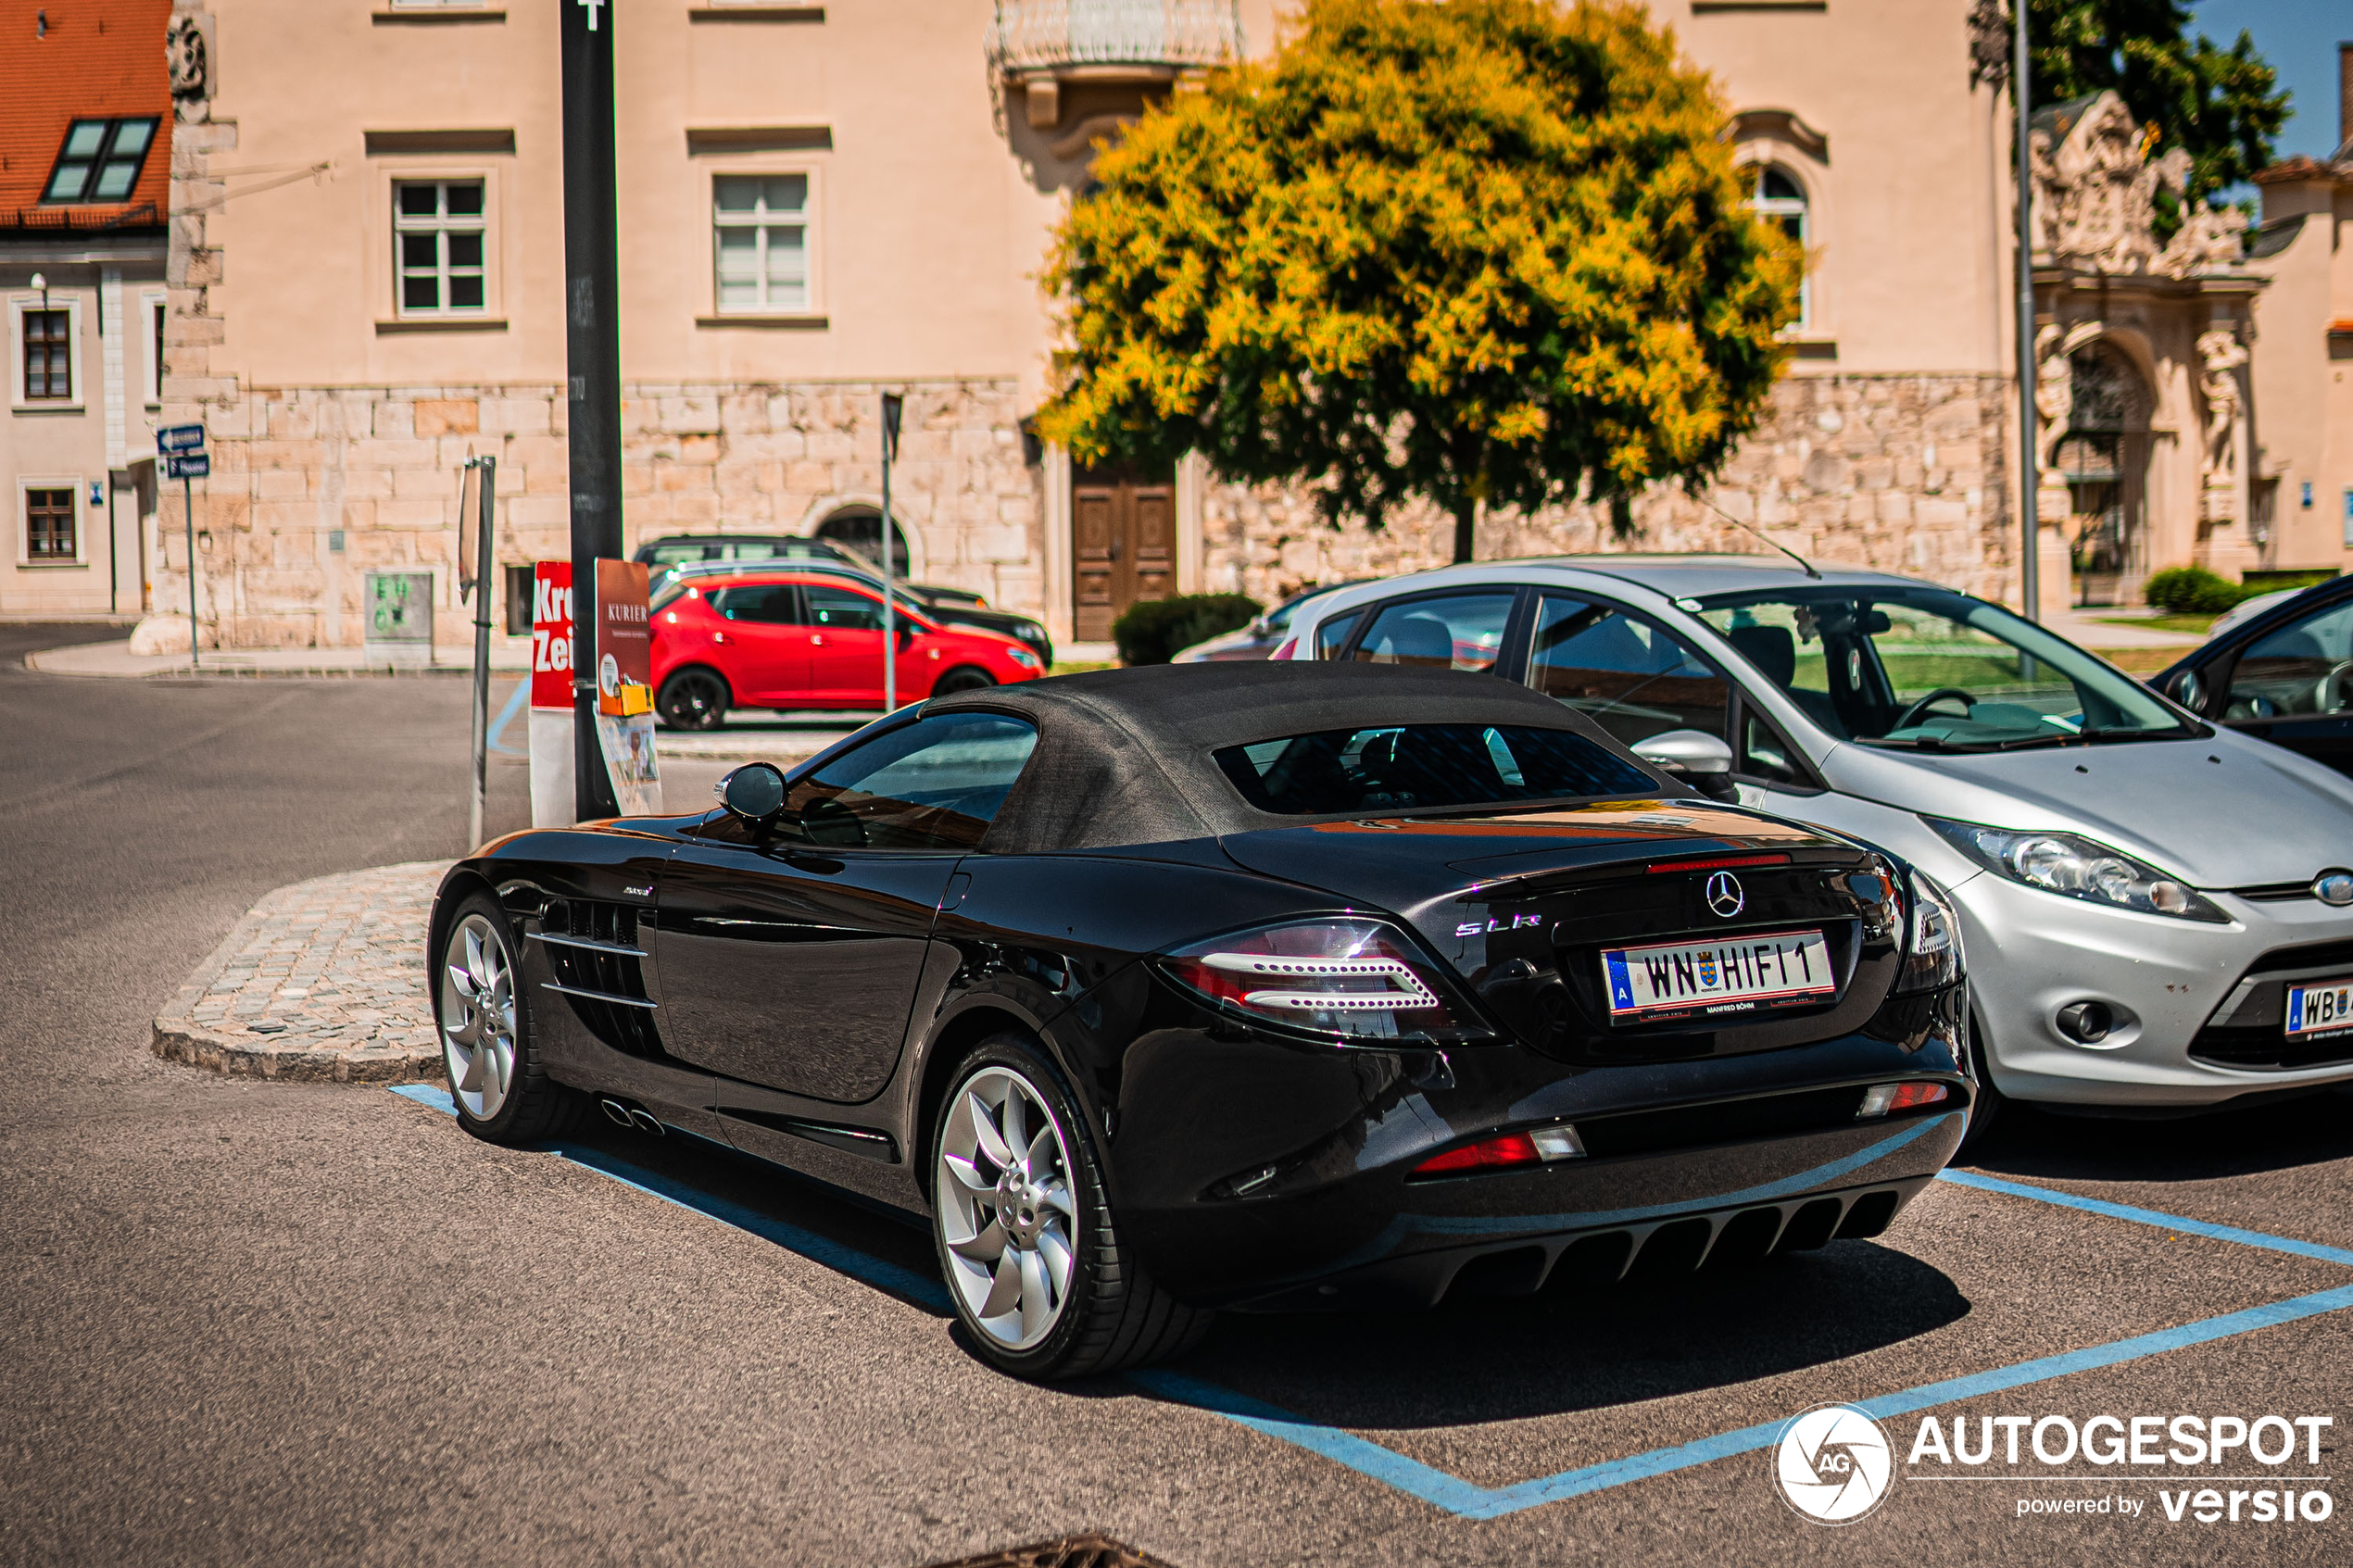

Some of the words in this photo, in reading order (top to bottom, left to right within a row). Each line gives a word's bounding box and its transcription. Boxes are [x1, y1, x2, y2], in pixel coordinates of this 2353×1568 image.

[608, 603, 648, 622] KURIER
[1455, 914, 1541, 936] SLR
[1644, 952, 1697, 999] WN
[1617, 987, 1628, 1001] A
[1706, 1005, 1736, 1014] MANFRED
[1736, 1001, 1755, 1011] BÖHM
[2306, 991, 2334, 1024] WB
